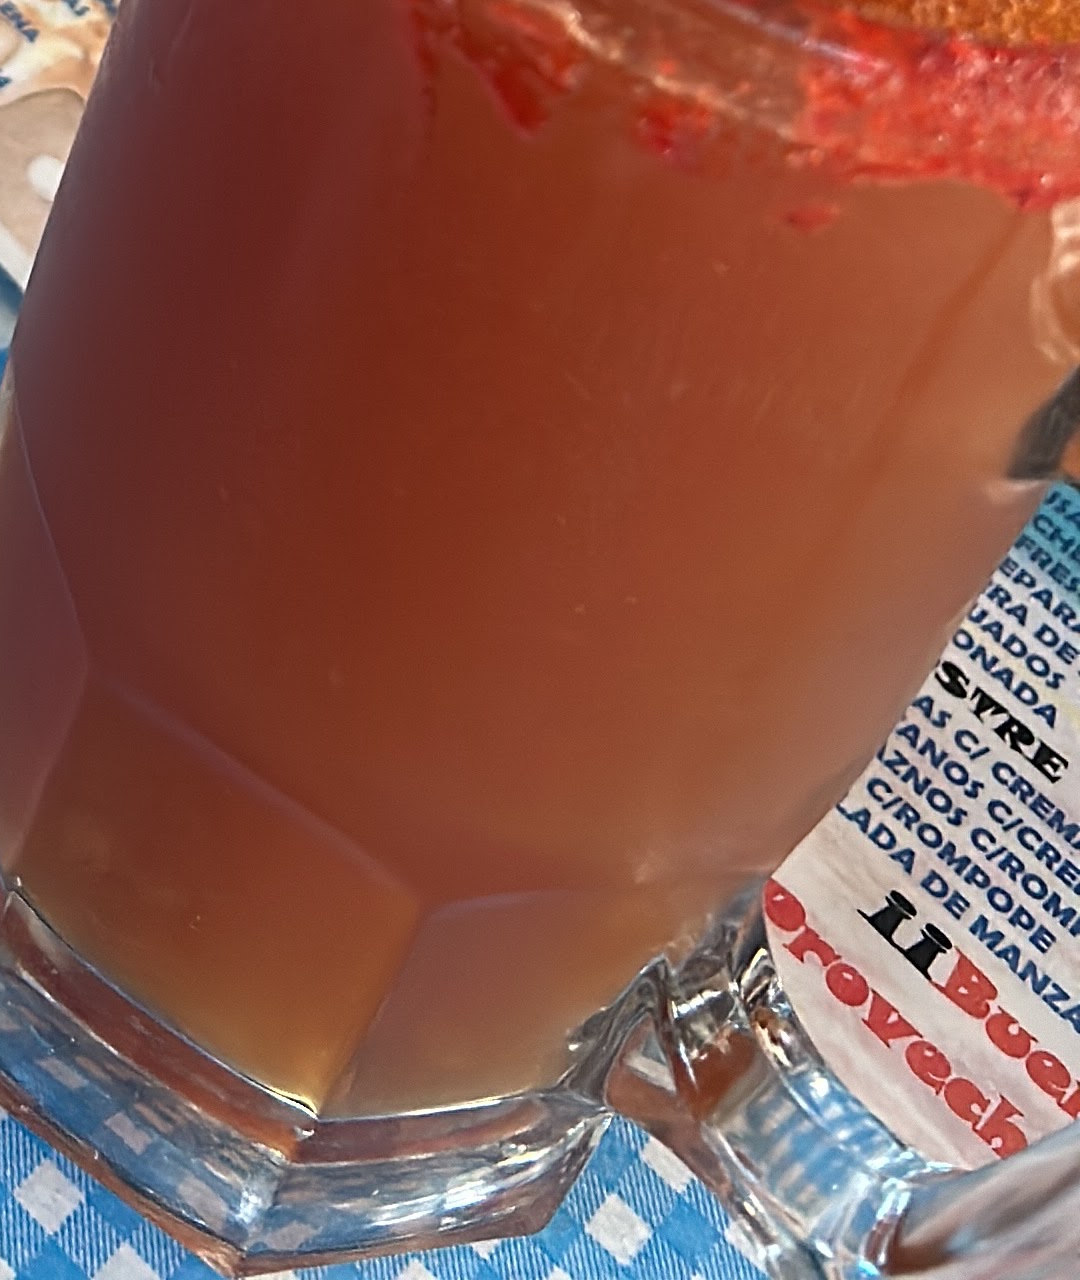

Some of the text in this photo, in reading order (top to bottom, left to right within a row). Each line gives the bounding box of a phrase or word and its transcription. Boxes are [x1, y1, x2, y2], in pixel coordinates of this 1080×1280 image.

[986, 578, 1079, 665] RA DE
[934, 658, 1071, 784] STRE
[950, 626, 1057, 729] ONADA
[895, 713, 985, 798] ANOS
[956, 731, 991, 759] C/
[867, 781, 1059, 955] C/ROMPOPE
[919, 870, 972, 920] DE
